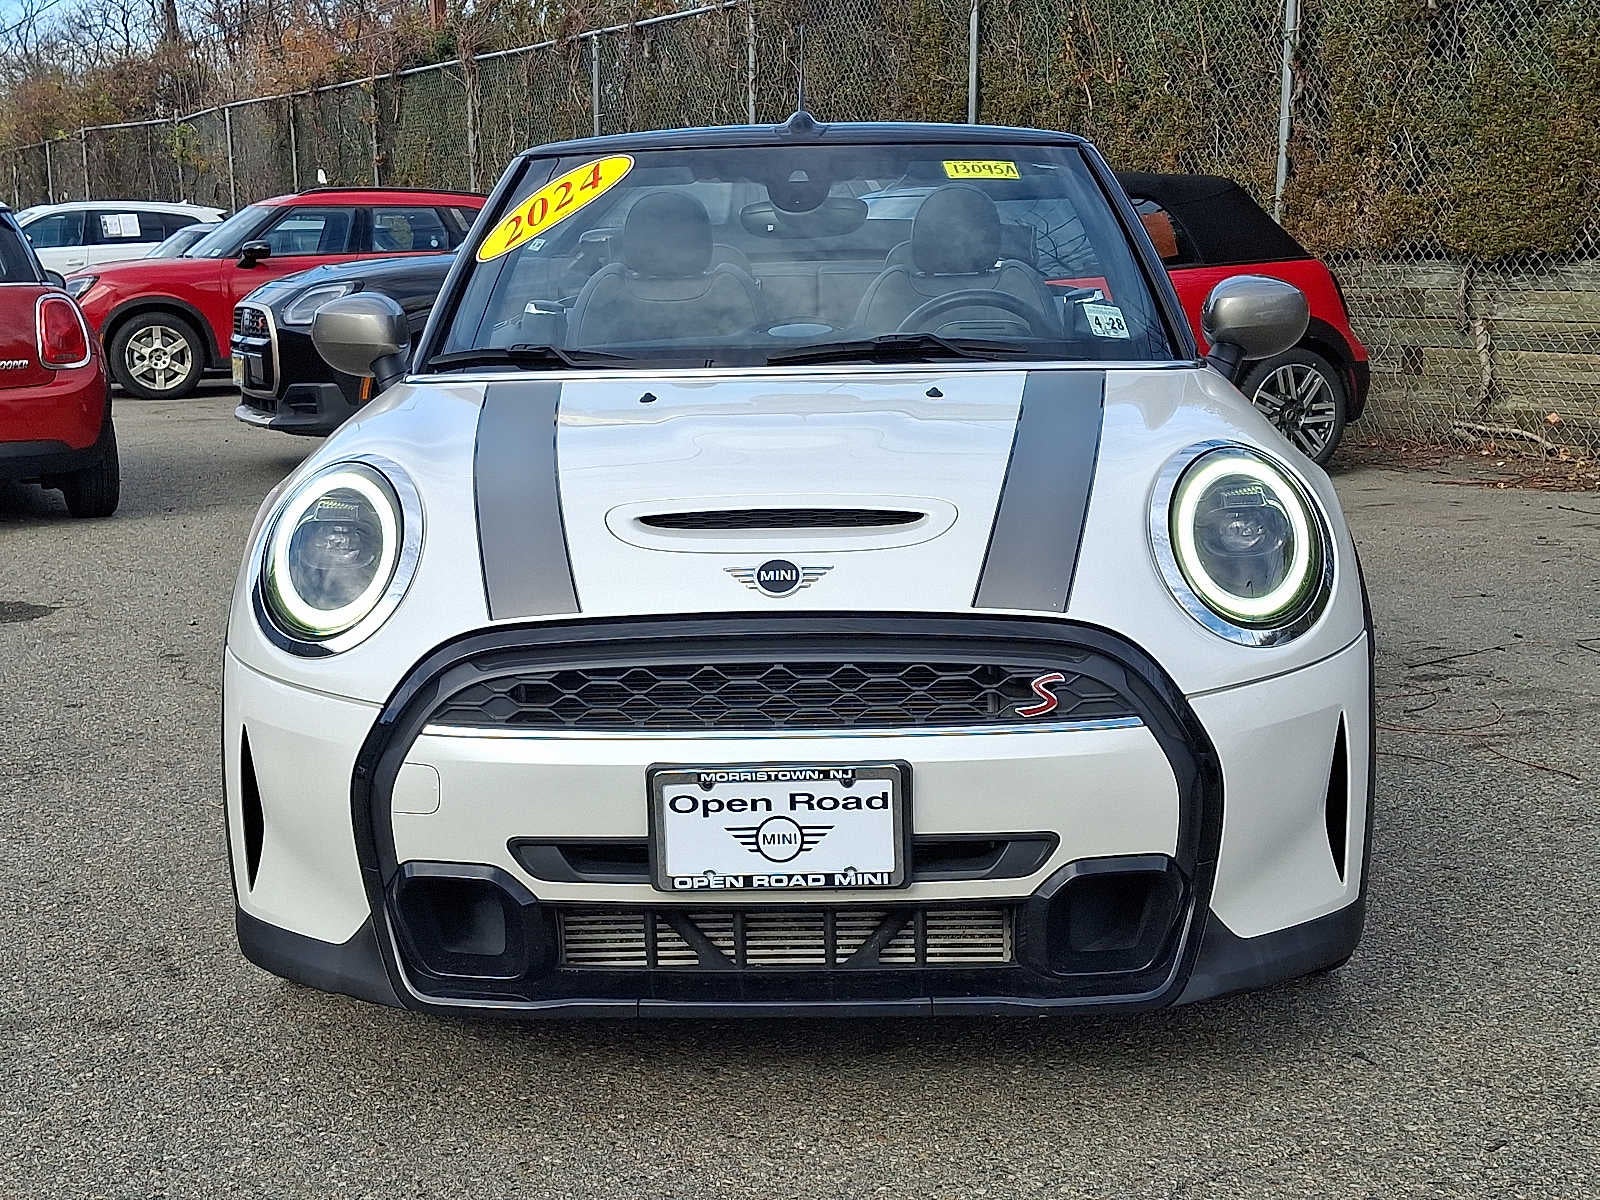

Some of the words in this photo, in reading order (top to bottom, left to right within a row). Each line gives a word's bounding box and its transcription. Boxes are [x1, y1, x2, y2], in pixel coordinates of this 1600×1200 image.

[503, 162, 603, 249] 2024
[760, 569, 797, 582] MINI
[1014, 672, 1066, 718] S
[700, 771, 824, 783] MORRISTOWN,
[829, 769, 853, 780] NJ
[668, 795, 773, 818] Open
[788, 791, 890, 812] Road
[762, 833, 798, 846] MINI
[673, 875, 745, 890] OPEN
[752, 874, 826, 888] ROAD
[834, 872, 890, 887] MINI
